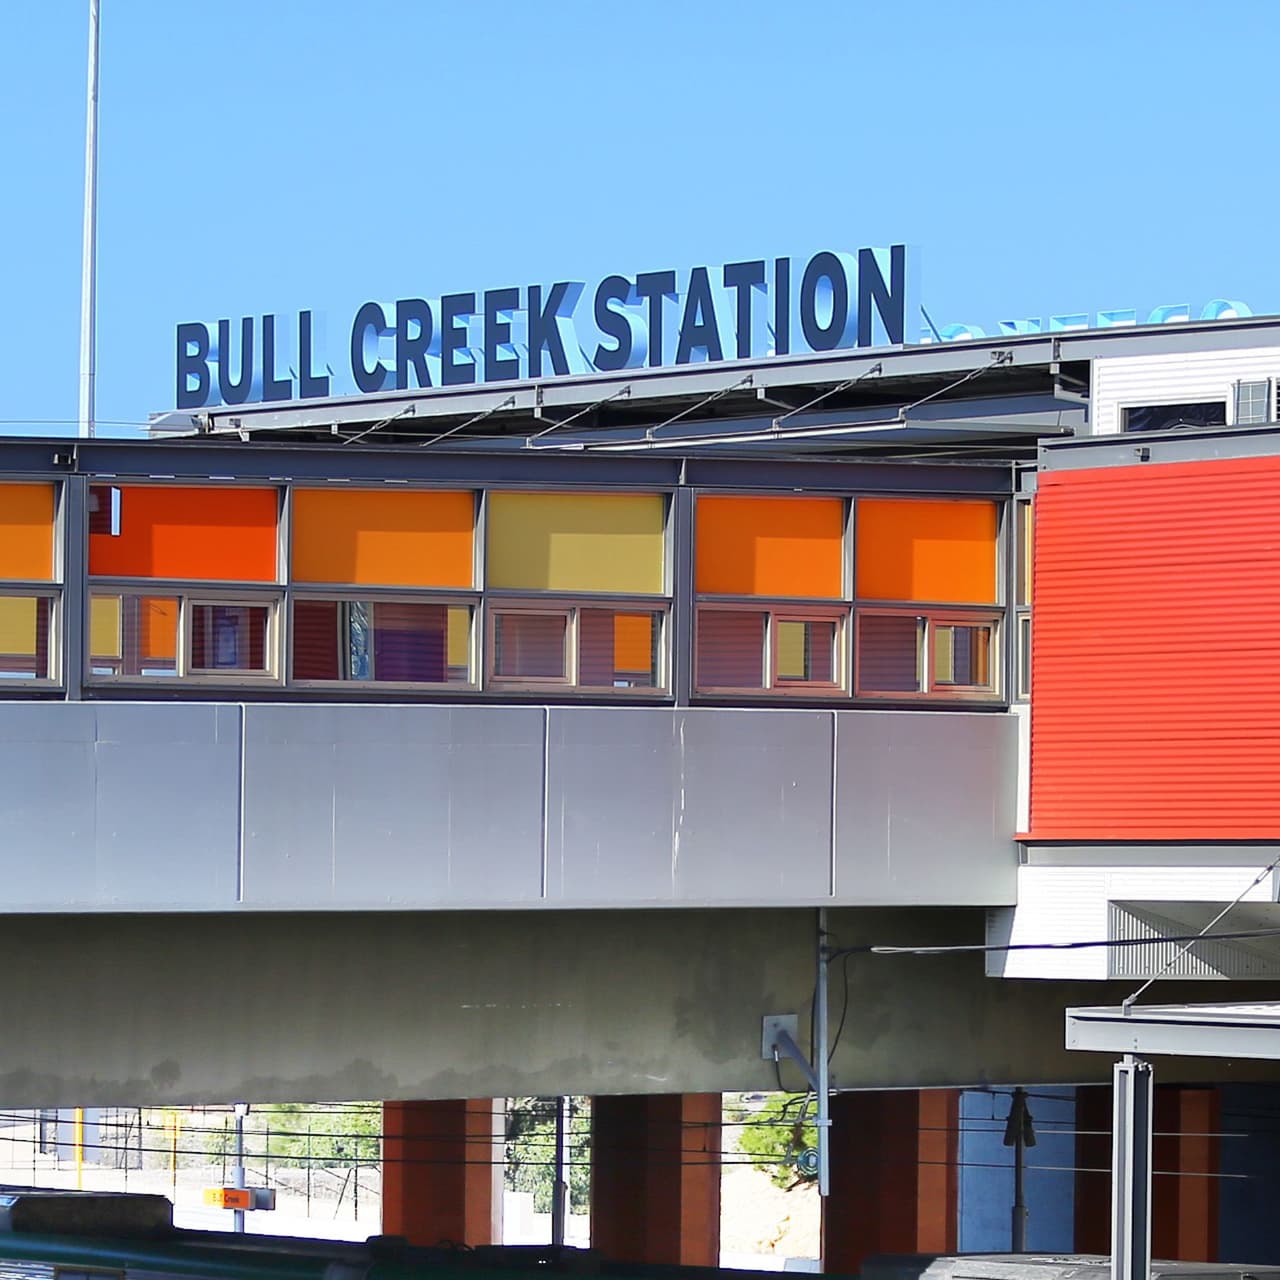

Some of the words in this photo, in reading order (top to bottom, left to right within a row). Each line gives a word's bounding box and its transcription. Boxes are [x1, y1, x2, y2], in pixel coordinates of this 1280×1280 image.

[177, 309, 331, 410] BULL
[350, 281, 572, 394] CREEK
[593, 245, 906, 371] STATION
